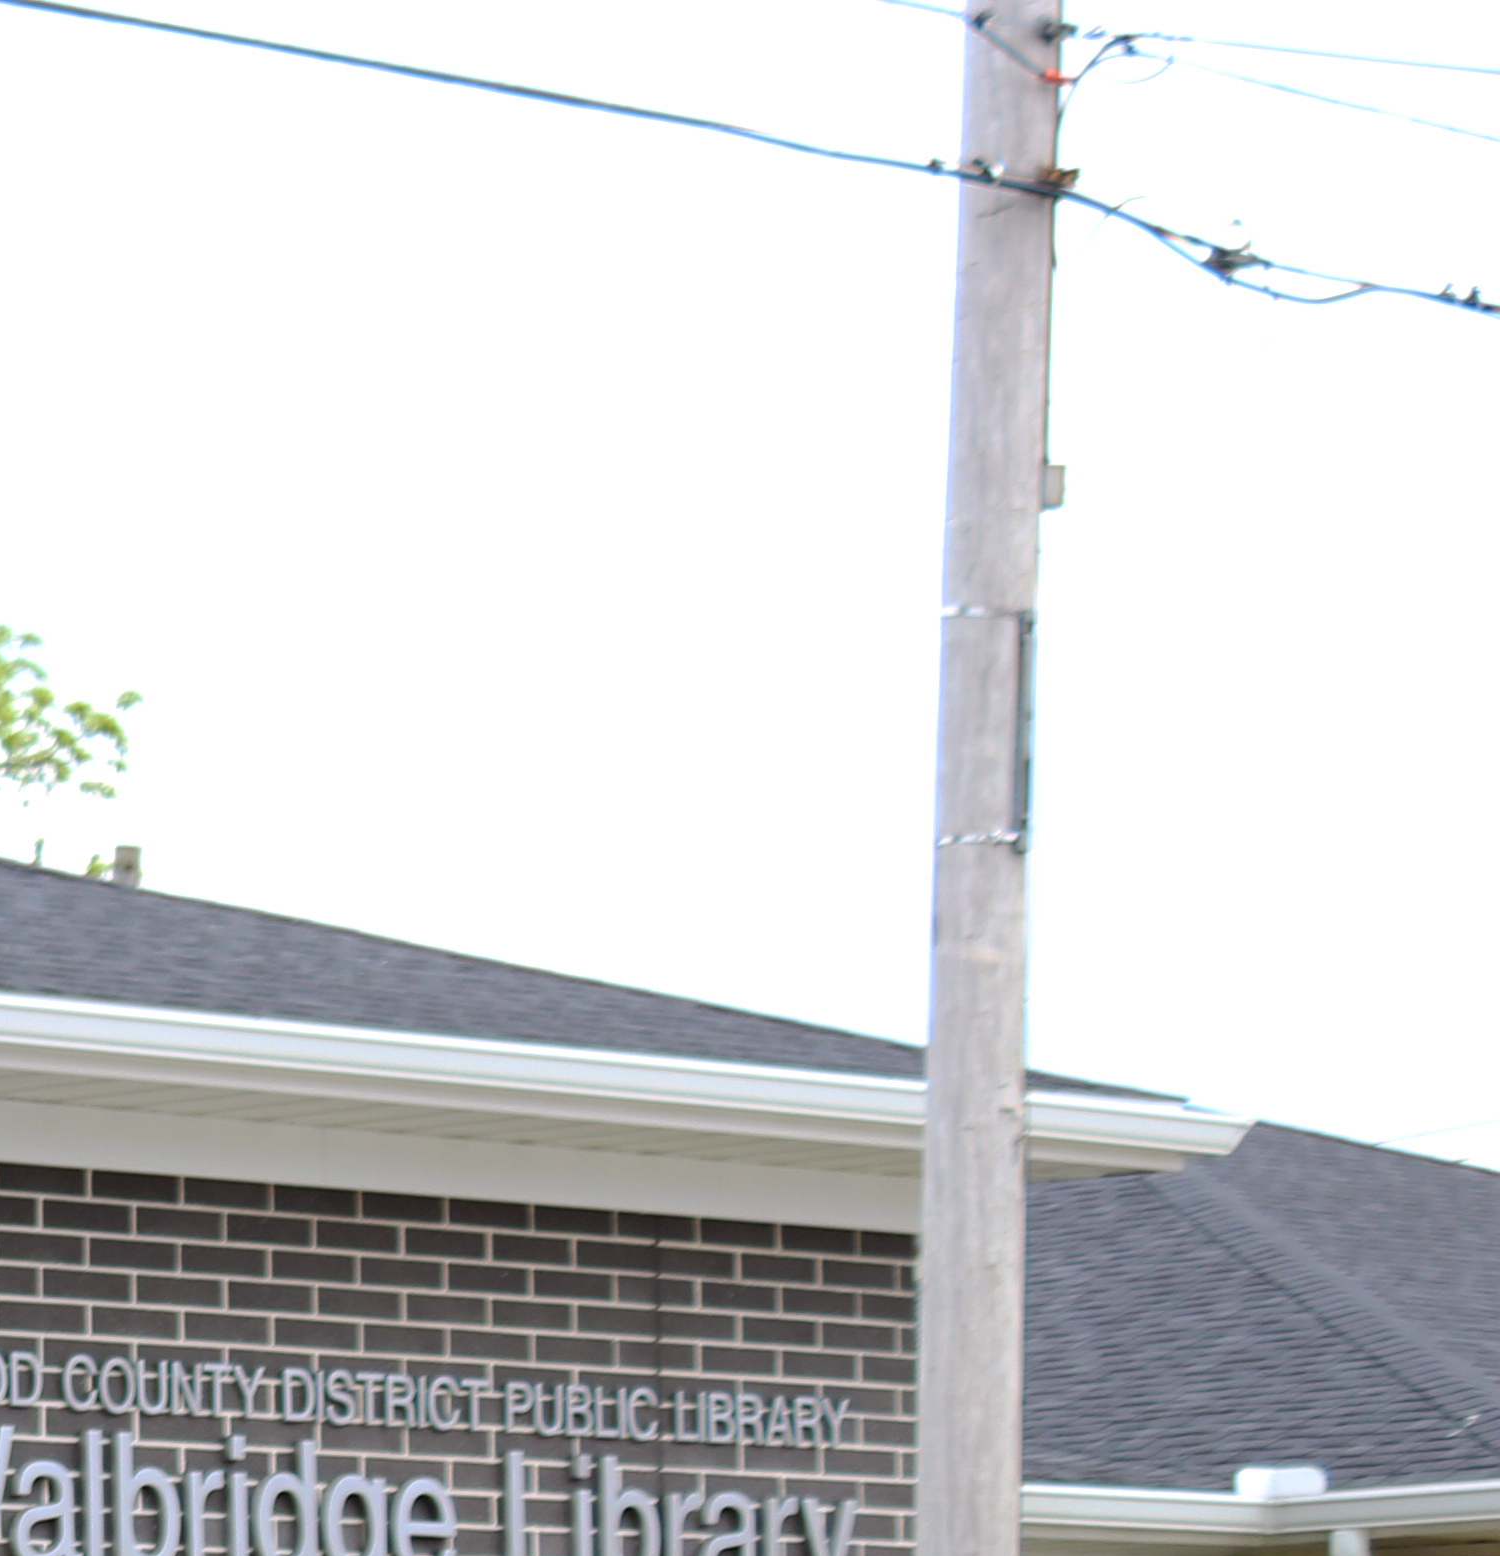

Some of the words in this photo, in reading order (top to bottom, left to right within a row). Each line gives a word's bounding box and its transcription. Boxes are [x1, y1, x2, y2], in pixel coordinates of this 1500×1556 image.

[61, 1353, 266, 1420] COUNTY
[282, 1366, 493, 1432] DISTRICT
[505, 1381, 660, 1442] PUBLIC
[675, 1389, 852, 1449] LIBRARY
